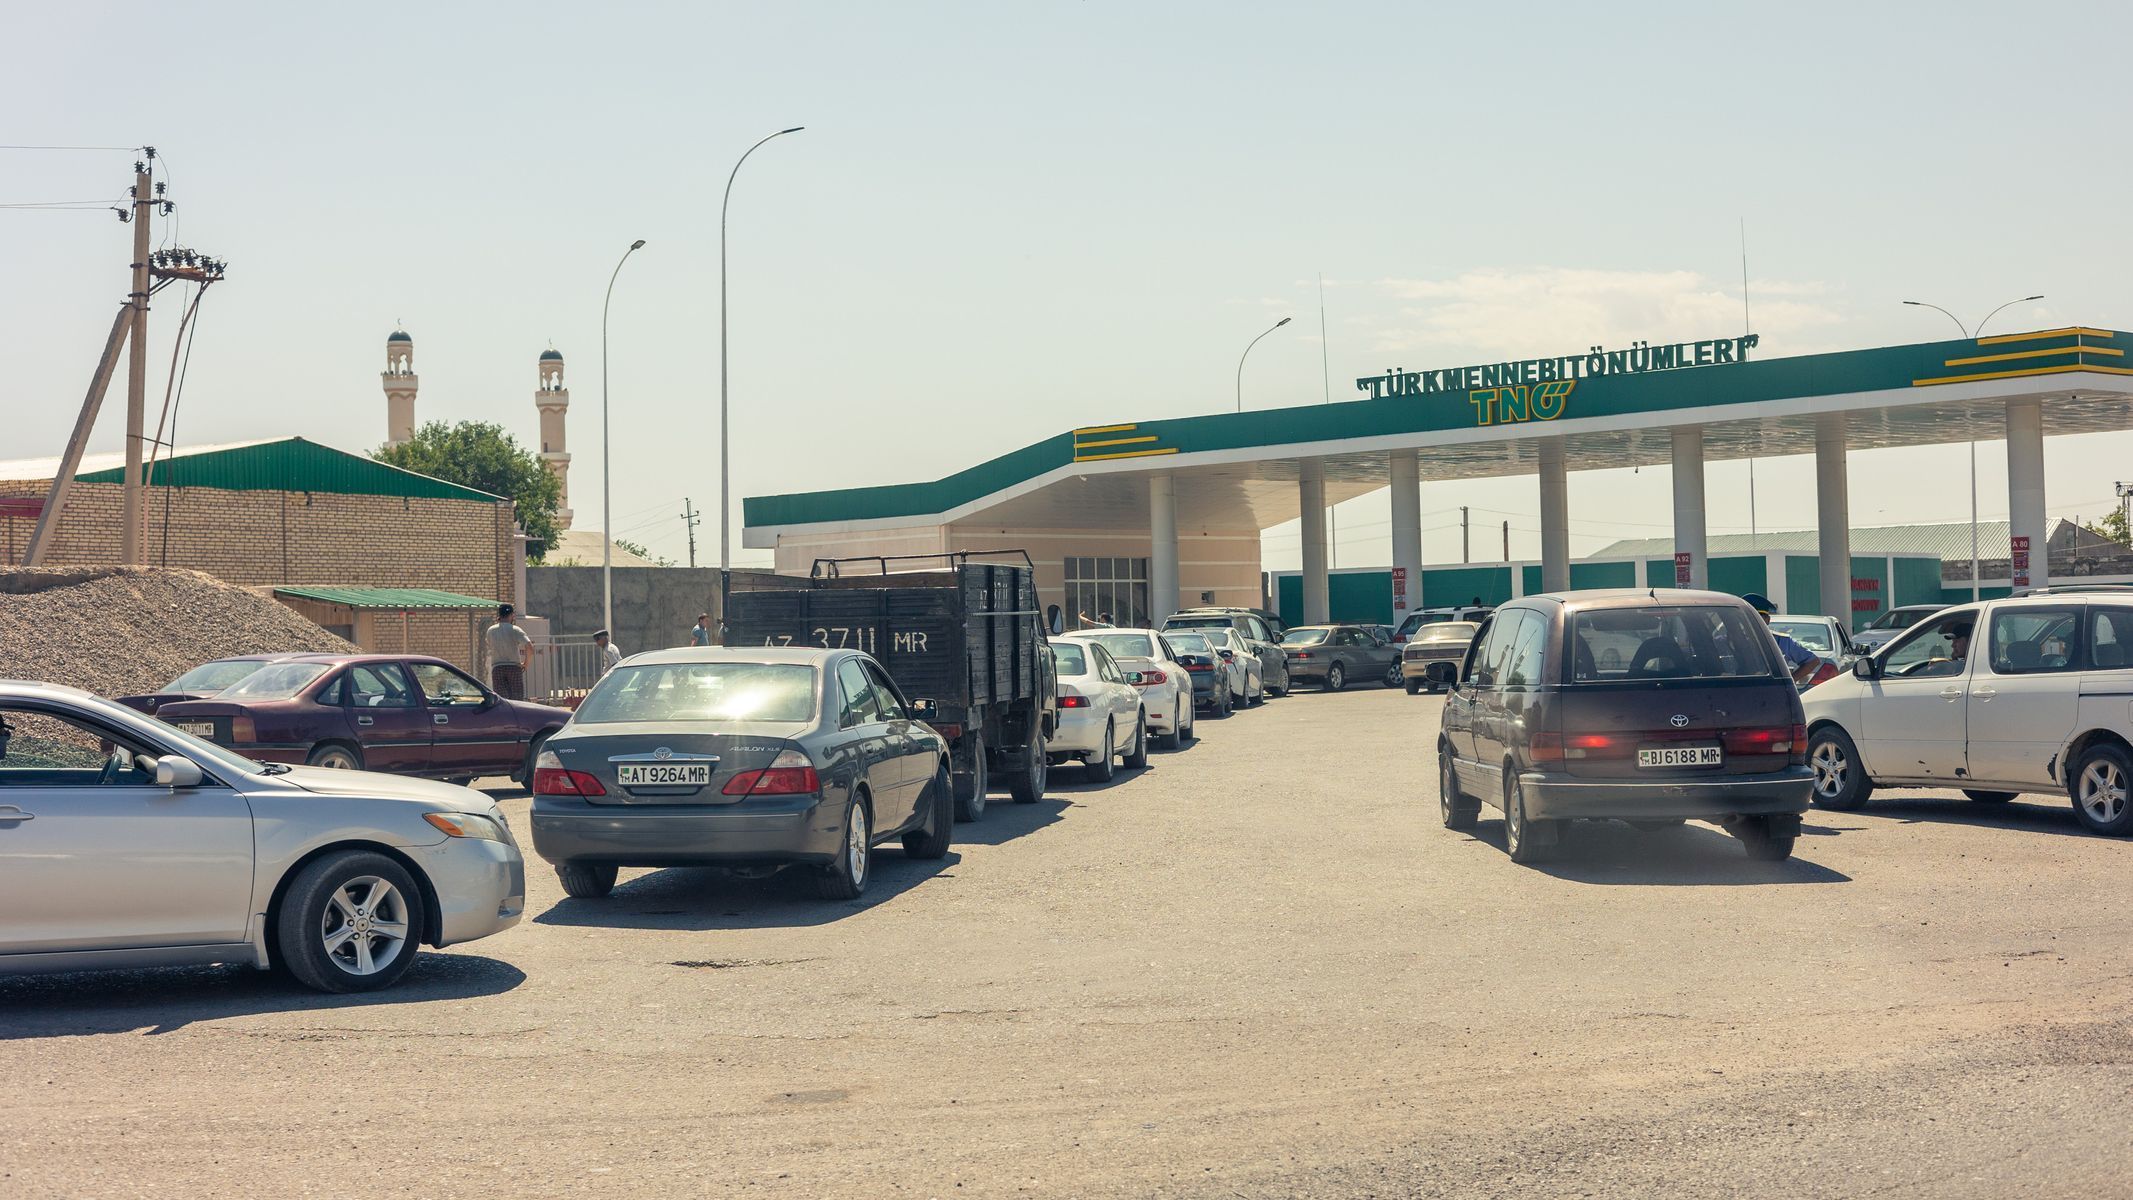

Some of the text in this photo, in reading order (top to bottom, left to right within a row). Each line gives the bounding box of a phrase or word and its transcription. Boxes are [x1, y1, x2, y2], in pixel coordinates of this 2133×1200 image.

[2019, 540, 2028, 548] 80
[812, 627, 875, 654] 3711
[894, 632, 928, 653] MR
[1650, 748, 1717, 765] BJ 6188 MR
[631, 767, 706, 783] AT 9264 MR
